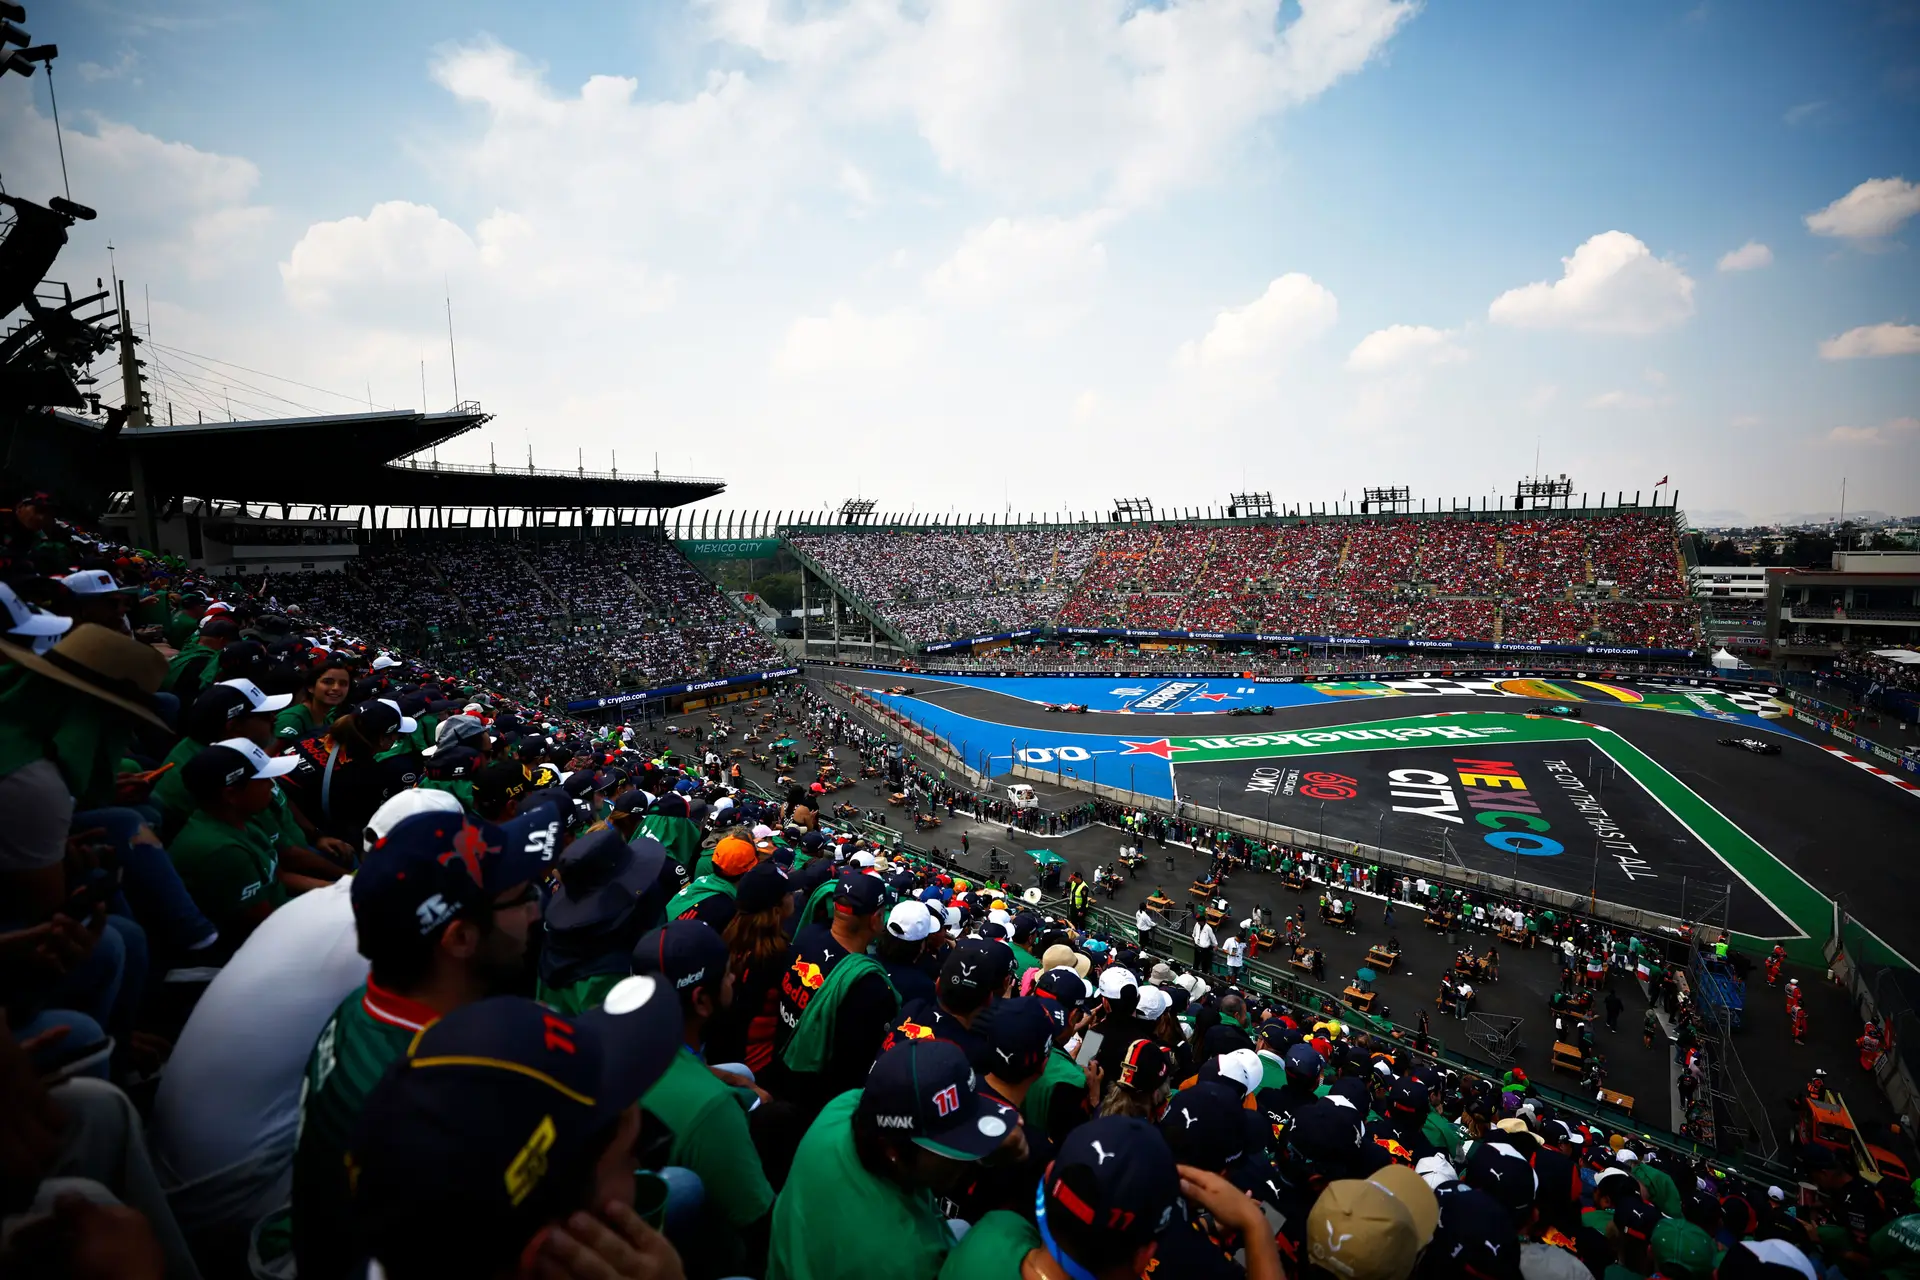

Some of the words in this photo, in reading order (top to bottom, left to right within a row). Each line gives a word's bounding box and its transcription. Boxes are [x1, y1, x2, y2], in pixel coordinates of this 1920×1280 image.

[694, 543, 737, 553] MEXICO
[739, 542, 762, 552] CITY
[1415, 640, 1452, 648] crypto.com
[1502, 643, 1541, 651] crypto.com
[1596, 646, 1638, 655] crypto.com
[769, 668, 798, 678] crypto.com
[694, 679, 728, 691] crypto.com
[607, 692, 646, 704] crypto.com
[1190, 726, 1490, 749] Heineken
[1832, 728, 1853, 743] Heineken
[1874, 746, 1898, 764] Heineken
[1543, 759, 1571, 773] THE
[1554, 772, 1588, 792] CITY
[1388, 768, 1464, 824] CITY
[1453, 758, 1564, 856] MEXICO
[1568, 794, 1606, 815] THAT
[1585, 815, 1626, 839] HAS
[1601, 839, 1639, 854] IT
[1612, 854, 1658, 881] ALL
[676, 966, 705, 989] telcel
[932, 1083, 960, 1117] 11
[876, 1114, 914, 1129] KAVAK
